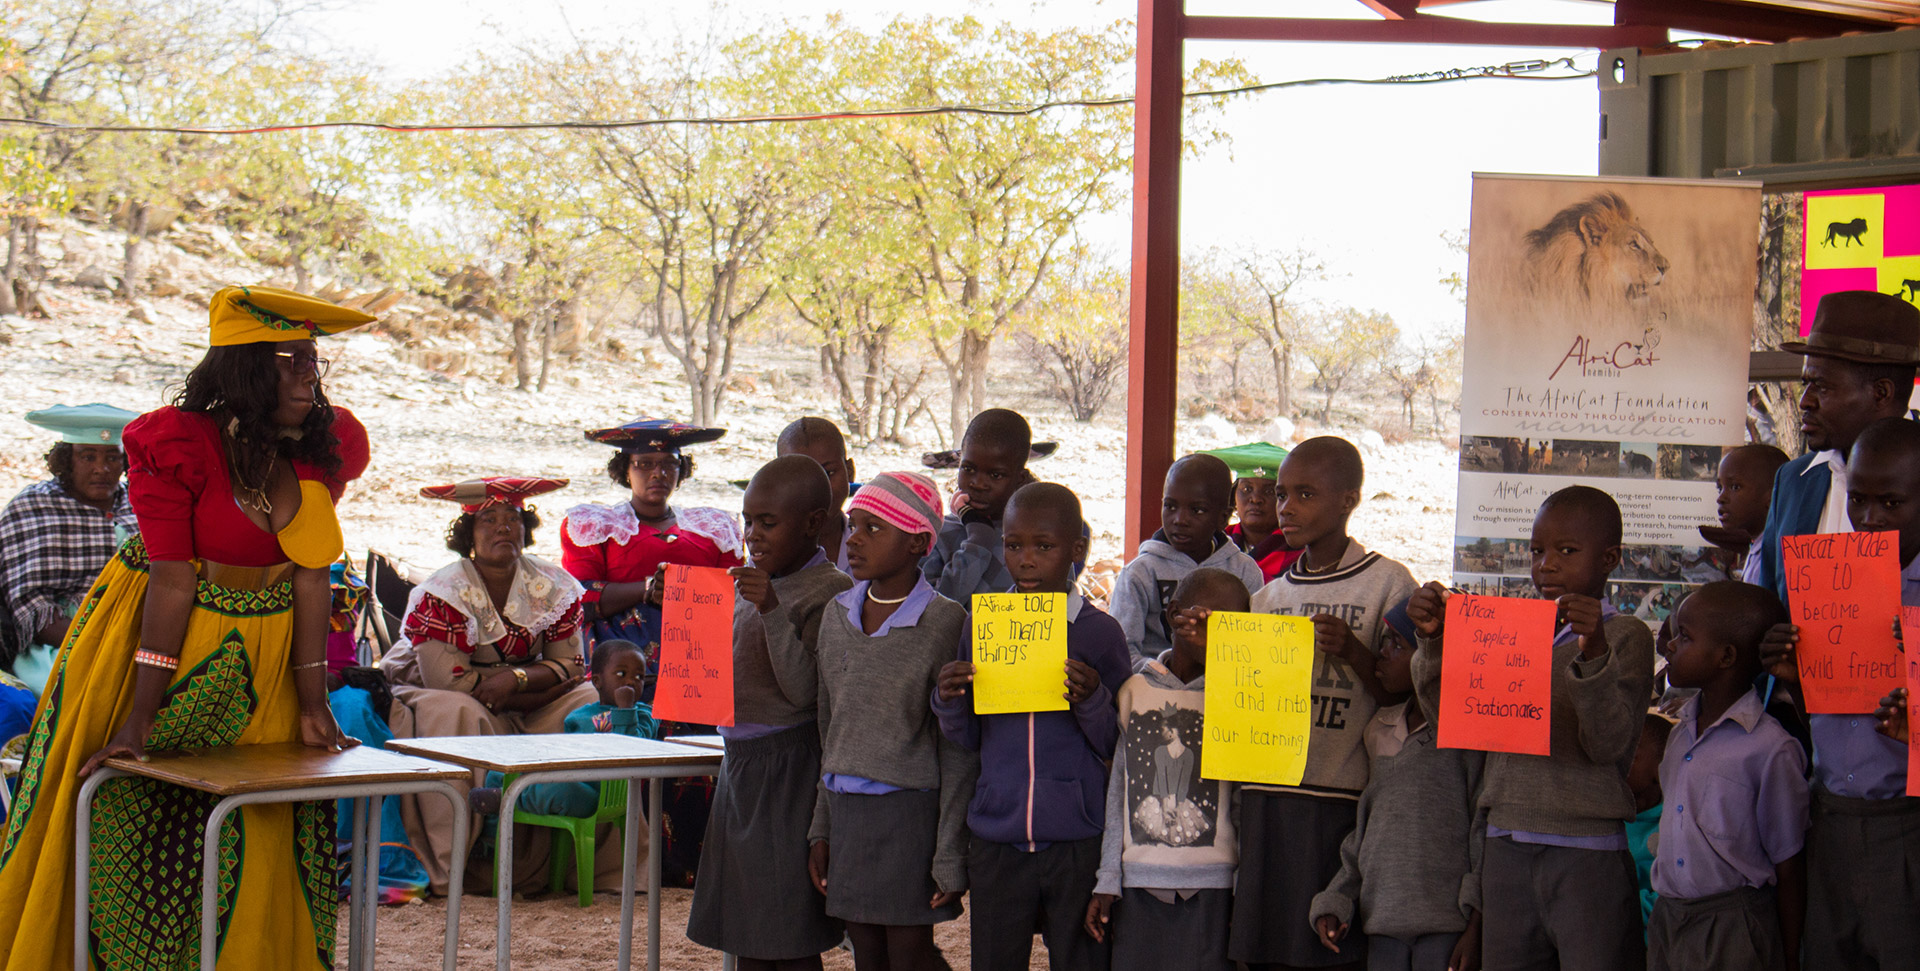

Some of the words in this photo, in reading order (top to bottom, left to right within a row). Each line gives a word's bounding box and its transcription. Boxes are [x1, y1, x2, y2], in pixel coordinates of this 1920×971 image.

[1549, 334, 1660, 381] AfriCat
[1587, 367, 1621, 378] namibia
[1503, 387, 1532, 408] The
[1540, 388, 1608, 411] AfriCat
[1614, 391, 1710, 414] Foundation
[1482, 409, 1578, 419] CONSERVATION
[1584, 413, 1645, 422] THROUGH
[1652, 415, 1727, 425] EDUCATION
[1515, 411, 1695, 438] namibia
[1493, 480, 1533, 500] AfriCat
[1616, 492, 1653, 501] long-term
[1654, 494, 1703, 503] conservation
[1478, 505, 1493, 513] Our
[1495, 506, 1523, 514] mission
[1622, 512, 1655, 520] tribution
[1668, 514, 1718, 523] conservation,
[1619, 502, 1652, 510] rnivores!
[1472, 514, 1502, 525] through
[1633, 521, 1667, 530] research,
[1623, 530, 1642, 540] unity
[693, 588, 724, 605] become
[684, 607, 693, 621] a
[977, 621, 994, 641] us
[1009, 618, 1054, 642] many
[1828, 624, 1843, 645] a
[977, 641, 1028, 665] things
[1270, 646, 1300, 665] our
[1847, 651, 1898, 680] friend
[1235, 666, 1264, 688] life
[1469, 671, 1486, 690] lot
[1234, 691, 1265, 712] and
[1277, 694, 1308, 714] into
[1211, 726, 1240, 743] our
[1249, 725, 1304, 756] learning
